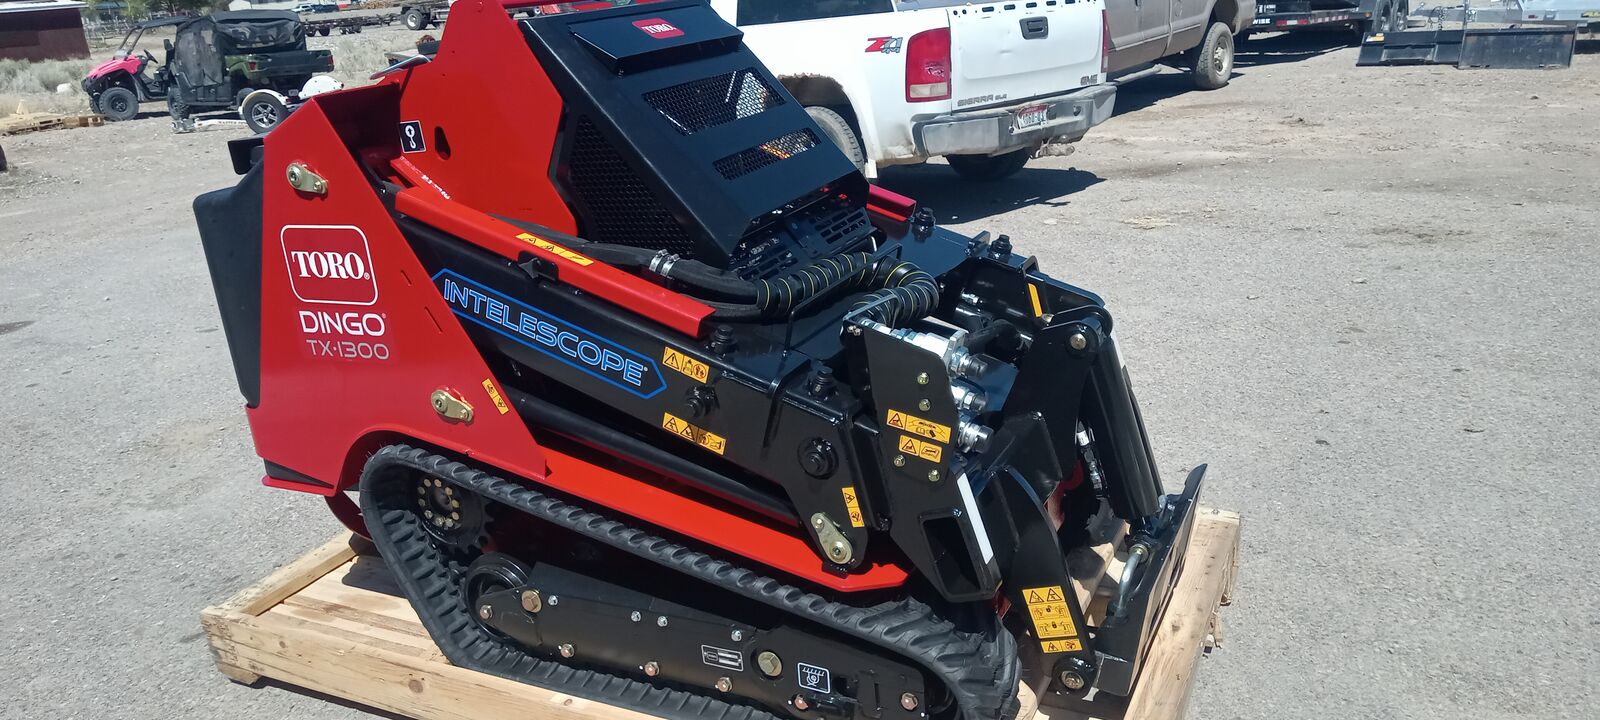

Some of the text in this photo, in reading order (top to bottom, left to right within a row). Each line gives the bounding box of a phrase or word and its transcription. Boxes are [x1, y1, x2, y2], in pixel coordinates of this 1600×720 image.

[641, 23, 674, 34] TORO
[957, 94, 994, 106] SIERRA
[291, 251, 365, 280] TORO
[298, 310, 386, 336] DINGO
[443, 278, 644, 387] INTELESCOPE
